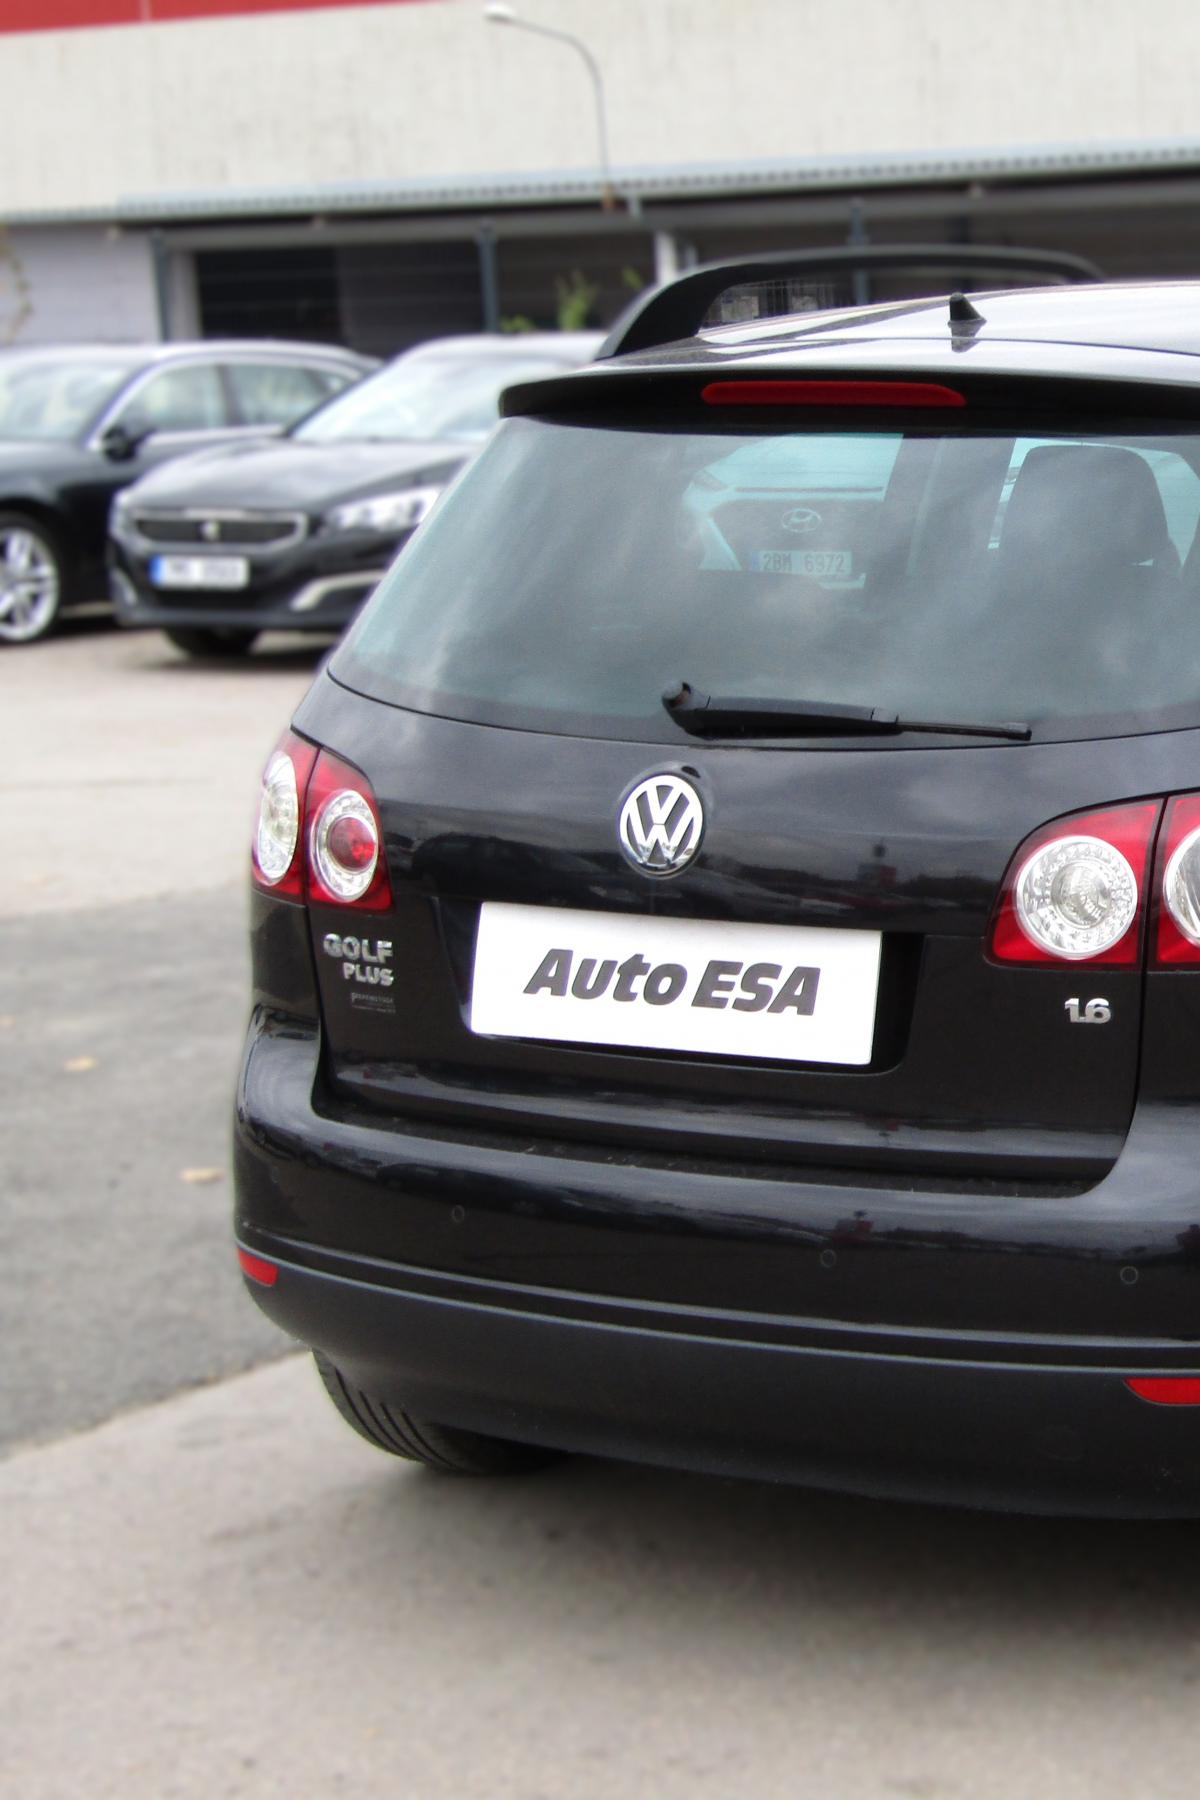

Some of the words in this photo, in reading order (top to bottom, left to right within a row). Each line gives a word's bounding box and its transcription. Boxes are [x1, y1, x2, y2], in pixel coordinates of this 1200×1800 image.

[323, 933, 393, 964] GOLF
[342, 962, 394, 986] PLUS
[523, 948, 688, 1005] Auto
[691, 960, 821, 1016] ESA
